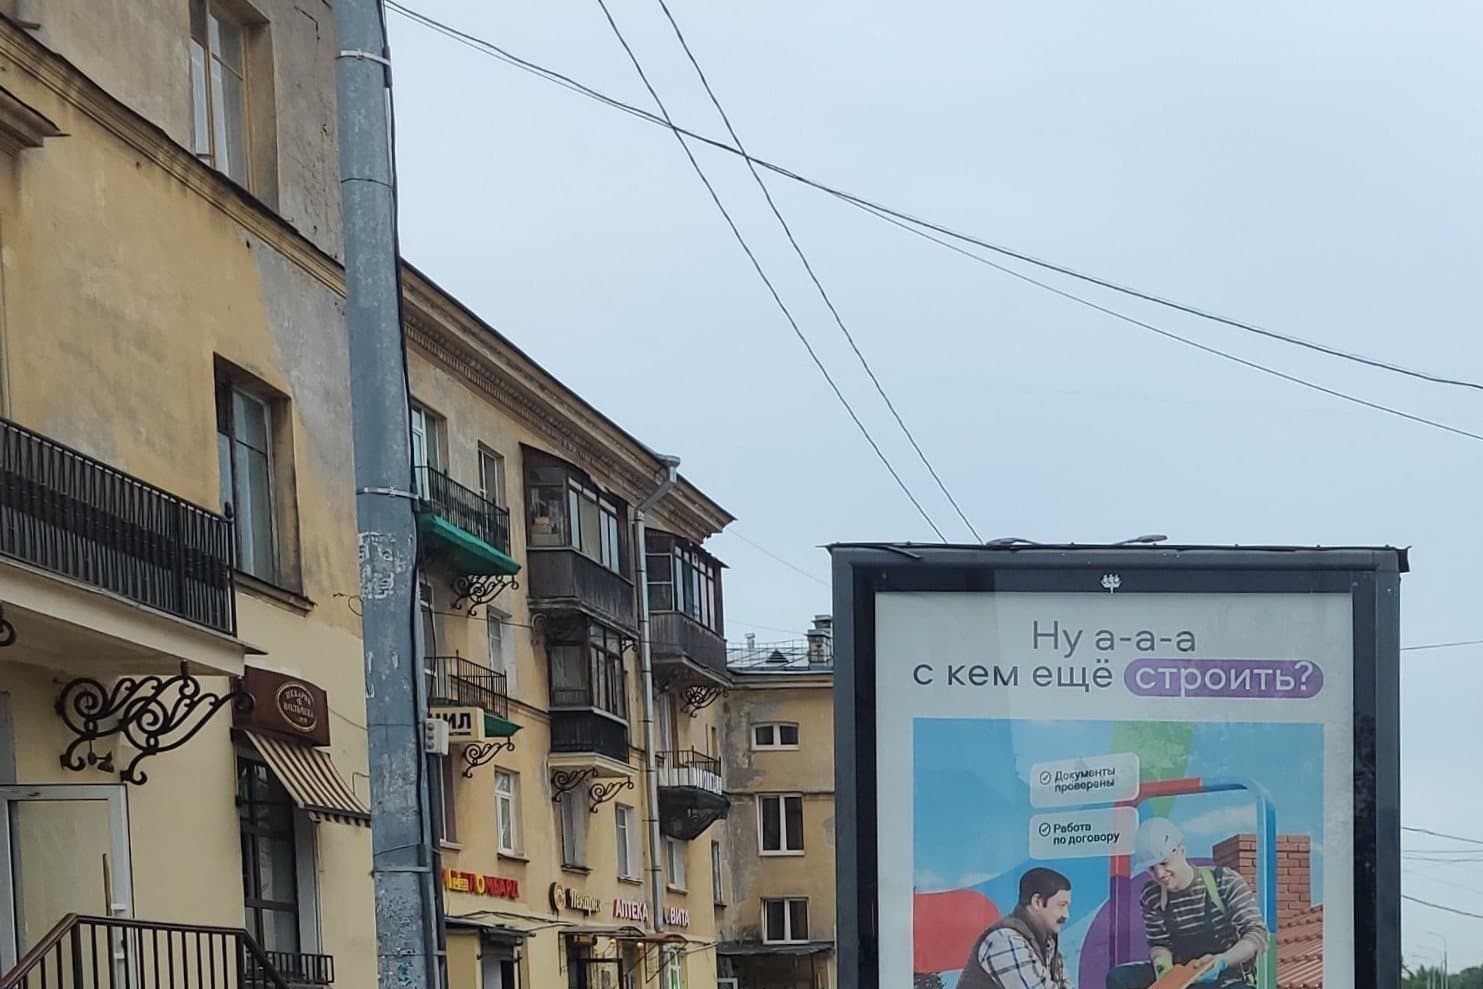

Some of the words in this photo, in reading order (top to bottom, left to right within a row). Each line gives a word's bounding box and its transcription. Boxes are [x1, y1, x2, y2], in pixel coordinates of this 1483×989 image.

[1033, 620, 1083, 658] Ну
[1095, 629, 1196, 652] а-а-а
[913, 664, 934, 685] с
[948, 664, 1018, 686] кем
[1032, 658, 1113, 692] ещё
[1135, 661, 1313, 697] строить?
[1054, 767, 1116, 783] Документы
[1054, 779, 1115, 794] проверены
[1053, 822, 1092, 834] Работа
[1053, 836, 1066, 845] по
[1068, 832, 1120, 845] договору
[614, 898, 649, 922] АПТЕКА
[670, 906, 691, 929] ВИТА
